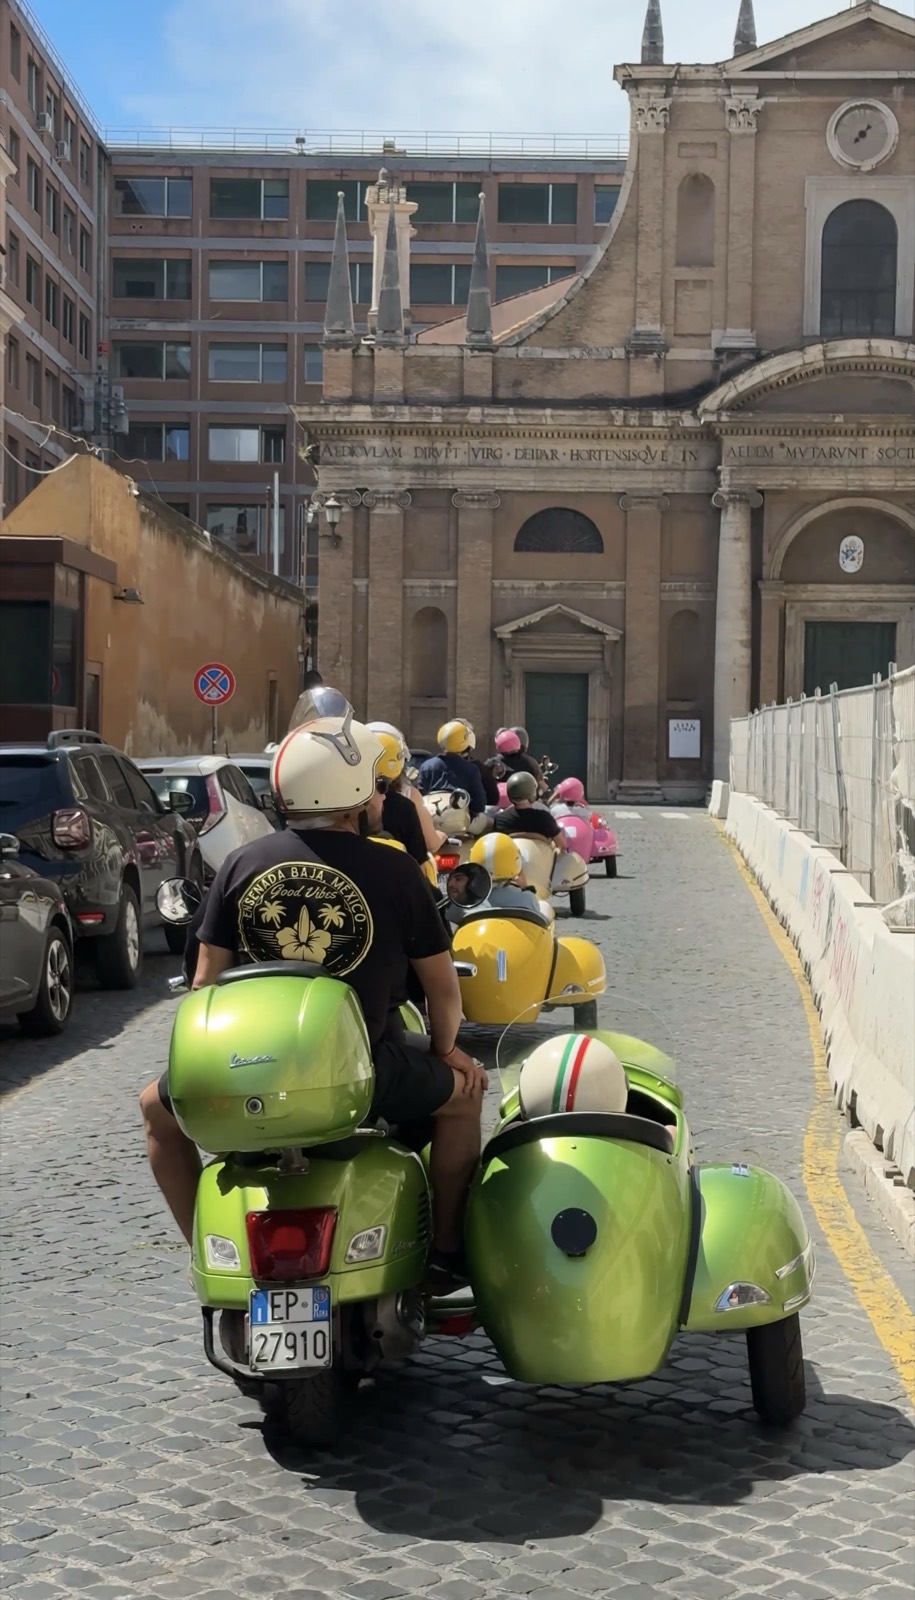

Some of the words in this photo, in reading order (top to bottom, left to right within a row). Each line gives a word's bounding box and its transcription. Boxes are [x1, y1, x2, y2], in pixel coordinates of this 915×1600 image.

[471, 447, 503, 460] VIRG
[682, 449, 698, 462] IN
[726, 446, 774, 458] AEDEM
[786, 446, 868, 459] MVTARVNT
[242, 869, 287, 919] ENSENADA
[330, 877, 367, 923] MEXICO
[270, 884, 305, 899] Good
[305, 886, 338, 899] Vibes
[270, 1291, 298, 1321] EP
[255, 1329, 327, 1363] 27910
